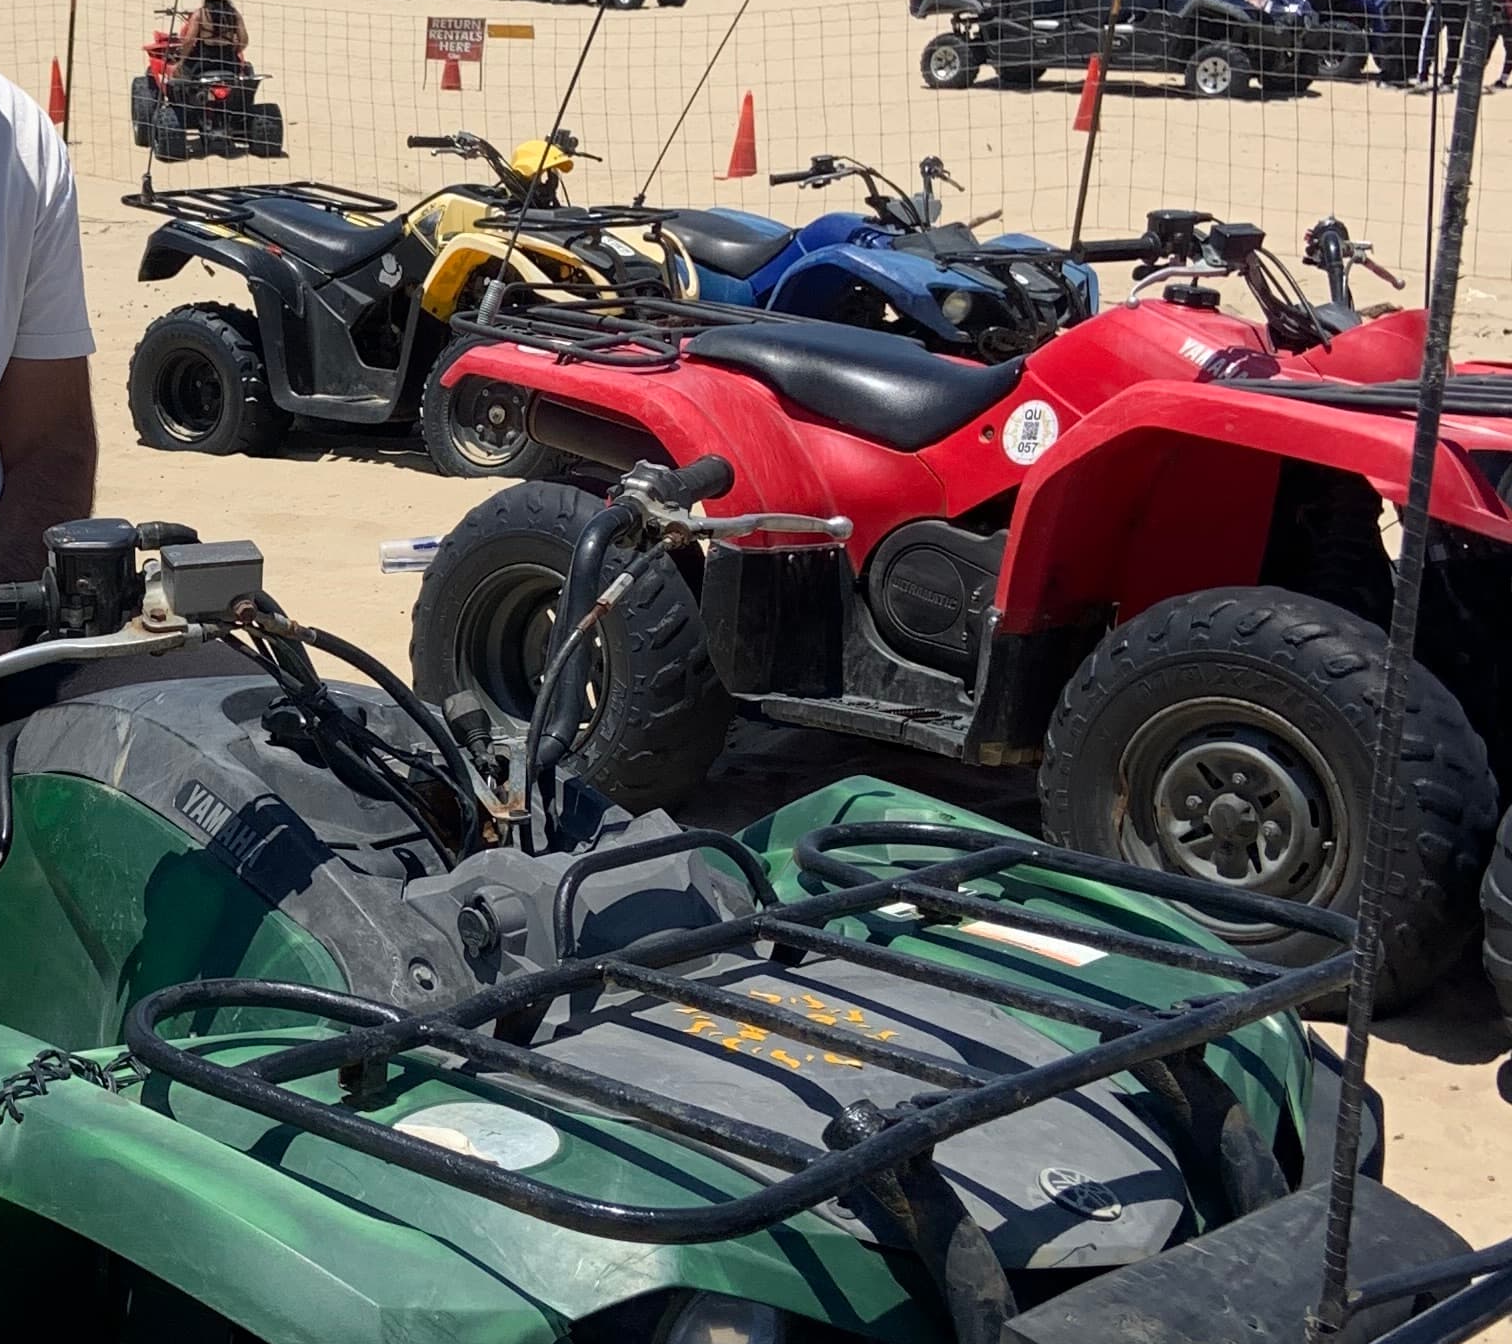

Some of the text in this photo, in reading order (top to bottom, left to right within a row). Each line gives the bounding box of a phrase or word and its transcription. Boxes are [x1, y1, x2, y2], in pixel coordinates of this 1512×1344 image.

[431, 18, 481, 30] RETURN
[429, 29, 483, 42] RENTALS
[439, 41, 472, 53] HERE
[1024, 407, 1042, 421] QU
[1017, 442, 1039, 454] 057
